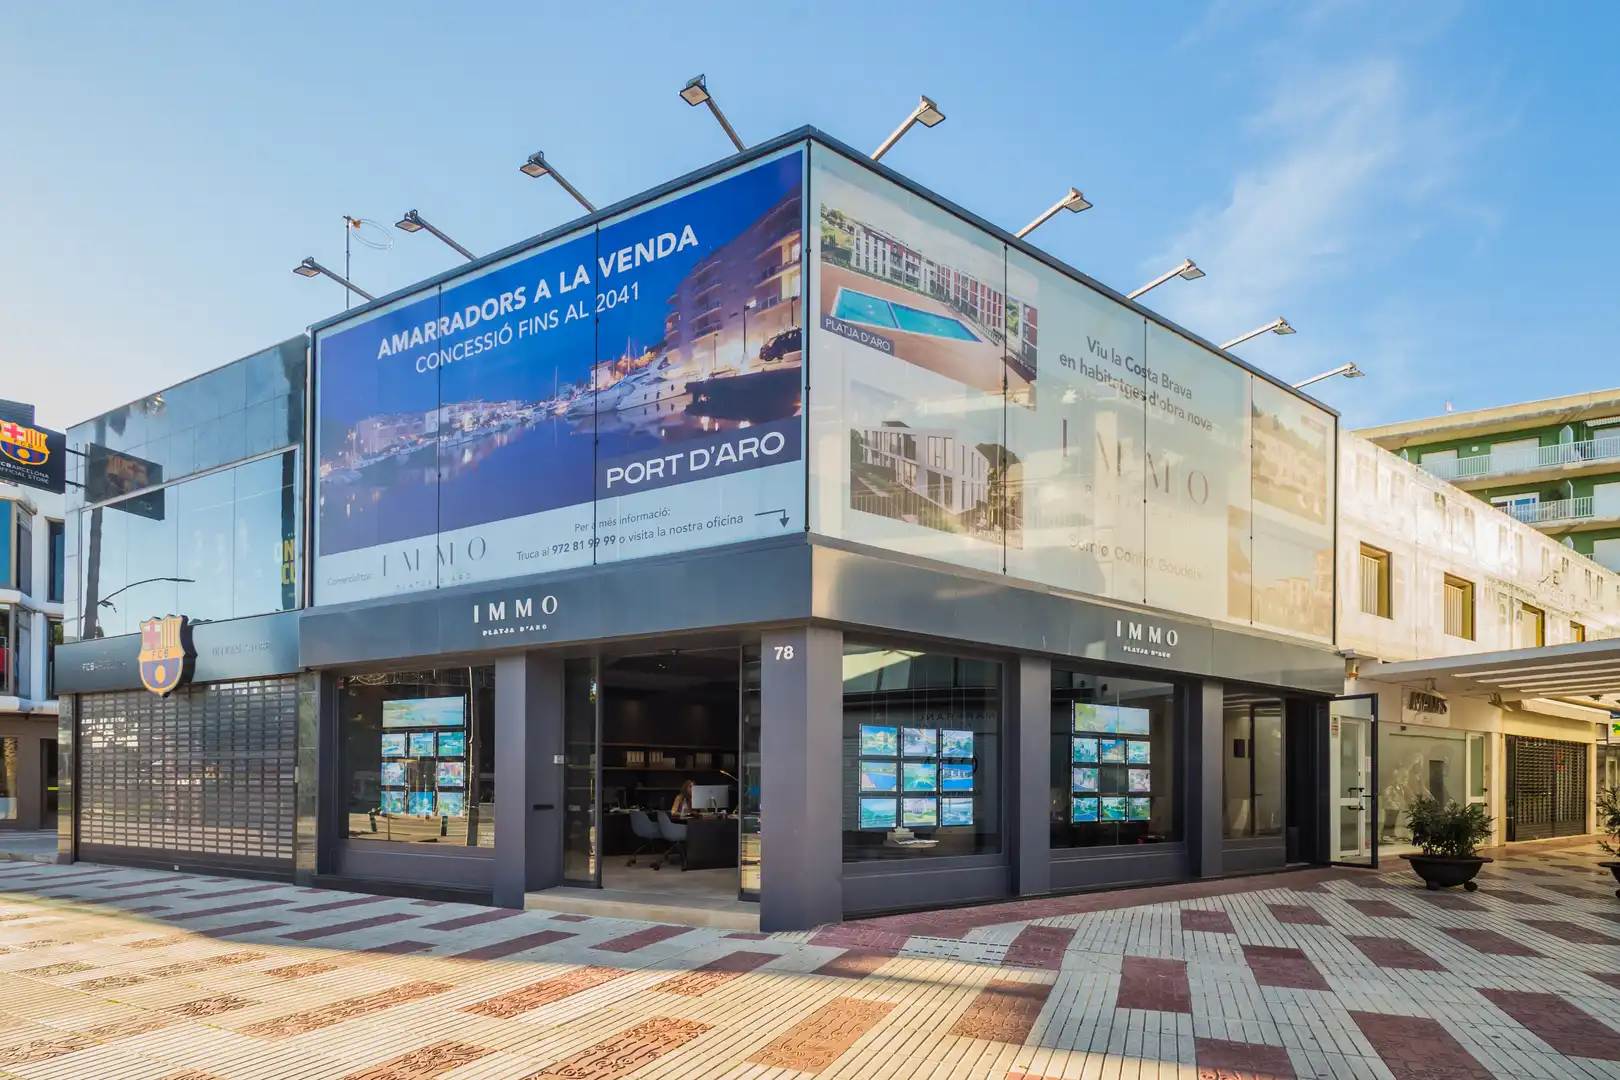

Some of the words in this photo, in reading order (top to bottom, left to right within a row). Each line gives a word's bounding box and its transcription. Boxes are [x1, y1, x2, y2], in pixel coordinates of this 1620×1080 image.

[378, 287, 526, 360] AMARRADORS
[534, 278, 552, 302] A
[560, 264, 590, 294] LA
[598, 224, 698, 278] VENDA
[416, 324, 514, 374] CONCESSIÓ
[519, 310, 560, 339] FINS
[564, 300, 589, 324] AL
[595, 282, 640, 314] 2041
[826, 318, 860, 340] PLATJA
[861, 332, 890, 351] D'ARO
[1086, 336, 1108, 358] Viu
[1112, 348, 1122, 366] la
[1125, 356, 1158, 384] Costa
[1162, 372, 1192, 400] Brava
[1060, 354, 1076, 370] en
[1080, 358, 1146, 400] habitatges
[1148, 391, 1184, 418] d'obra
[1188, 413, 1212, 432] nova
[0, 461, 50, 478] CBARCELONA
[606, 453, 684, 488] PORT
[690, 431, 785, 472] D'ARO
[575, 522, 588, 532] Per
[599, 516, 617, 528] més
[620, 508, 670, 526] informació:
[516, 550, 540, 561] Truca
[542, 546, 550, 556] al
[552, 543, 570, 554] 972
[572, 540, 584, 550] 81
[588, 538, 600, 548] 99
[604, 534, 616, 546] 99
[618, 536, 626, 544] o
[628, 529, 654, 542] visita
[656, 526, 666, 537] la
[669, 522, 702, 535] nostra
[706, 514, 744, 530] oficina
[382, 536, 486, 576] IMMO
[440, 573, 472, 584] DARO
[474, 596, 558, 624] IMMO
[482, 628, 515, 636] PLATJA
[520, 624, 547, 632] D'ARO
[1116, 620, 1178, 646] IMMO
[152, 648, 168, 659] FCB
[774, 646, 794, 660] 78
[1124, 646, 1148, 655] PLATJA
